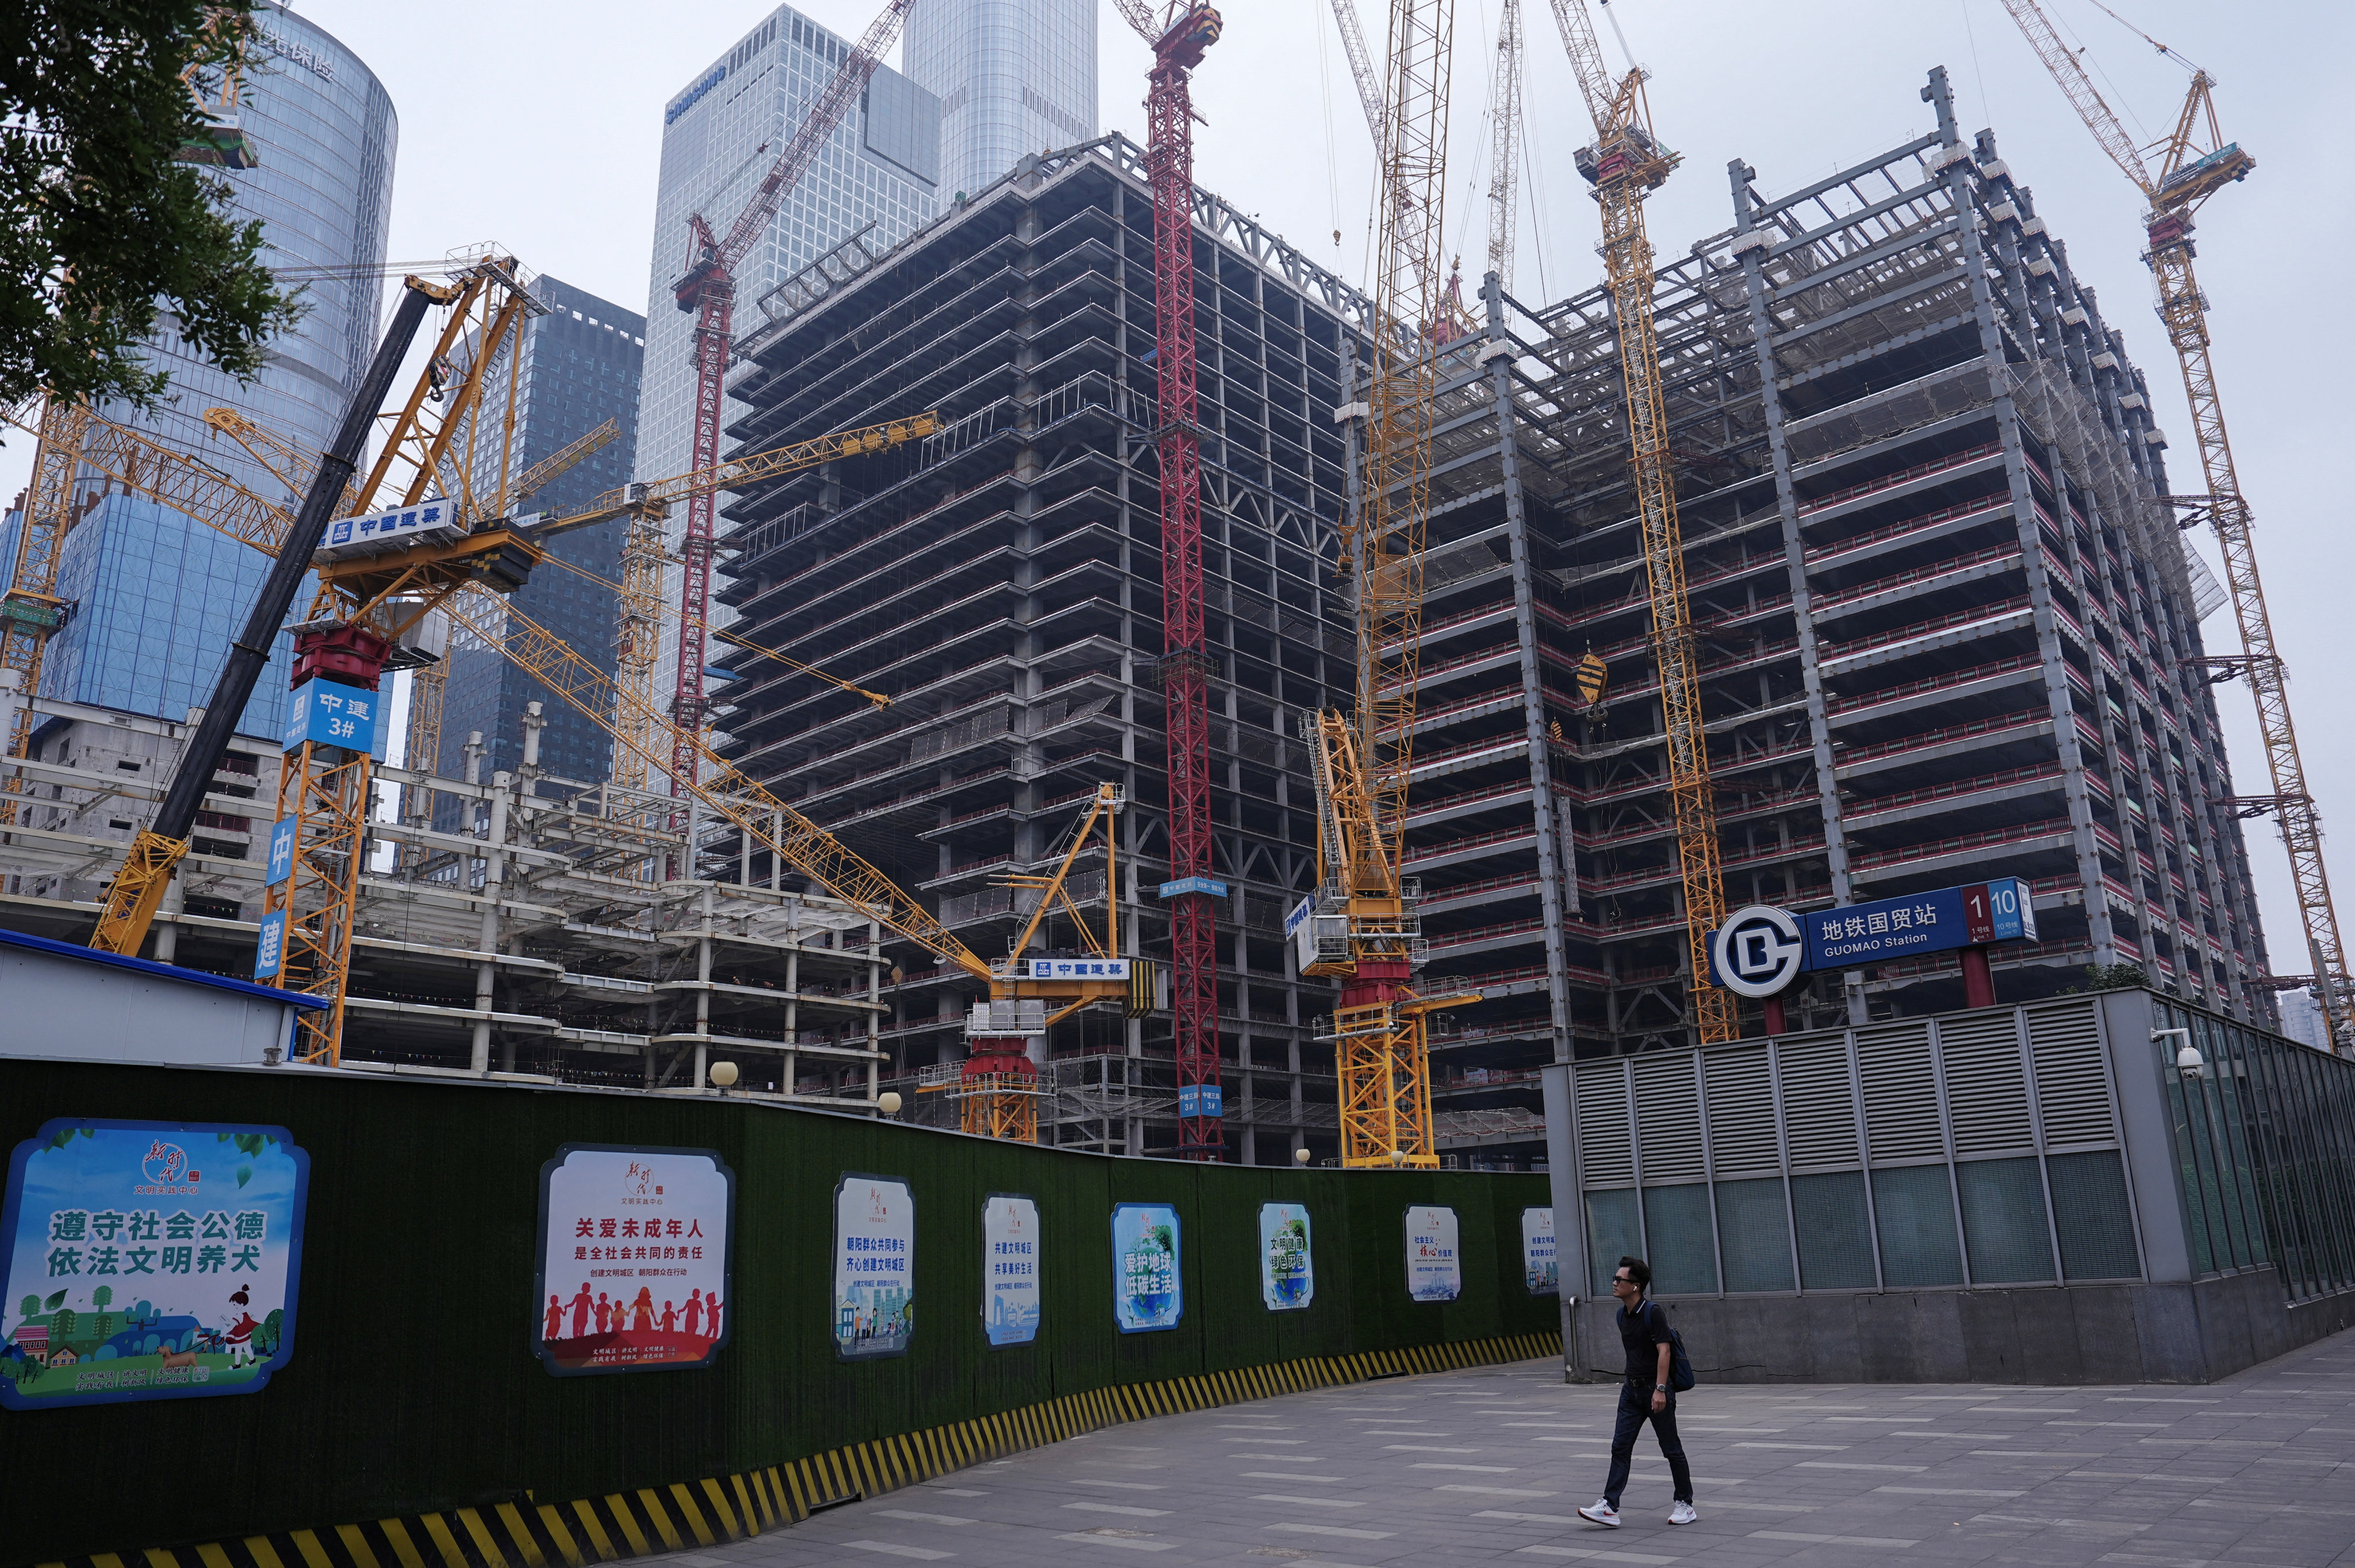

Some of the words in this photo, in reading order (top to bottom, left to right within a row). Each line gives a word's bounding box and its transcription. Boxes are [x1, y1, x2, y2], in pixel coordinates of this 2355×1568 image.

[255, 22, 335, 82] 光保险
[665, 65, 726, 125] SAMSUNG
[320, 694, 369, 721] 中建
[328, 718, 355, 738] 3#
[1970, 895, 1982, 918] 1
[1991, 890, 2016, 914] 10
[1822, 903, 1937, 941] 地铁国贸站
[1824, 940, 1880, 957] GUOMAO
[1885, 932, 1927, 948] Station
[1185, 1103, 1193, 1111] 3#
[133, 1186, 198, 1194] 文明实践中心
[52, 1211, 264, 1242] 遵守社会公德
[576, 1218, 703, 1238] 关爱未成年人
[574, 1246, 703, 1260] 是全社会共同的责任
[847, 1236, 905, 1252] 朝阳群众共同参与
[995, 1242, 1032, 1254] 共建文明城区
[1271, 1237, 1303, 1251] 文明健康
[1420, 1244, 1437, 1257] 核心
[48, 1245, 260, 1277] 依法文明养犬
[846, 1257, 905, 1272] 齐心创建文明城区
[995, 1262, 1032, 1275] 共享美好生活
[1125, 1252, 1171, 1274] 爱护地球
[1271, 1254, 1304, 1269] 绿色环保
[590, 1269, 634, 1277] 创建文明城区
[639, 1268, 687, 1277] 朝阳群众在行动
[1125, 1274, 1172, 1297] 低碳生活
[78, 1371, 114, 1380] 文明城区
[157, 1366, 189, 1375] 文明健康
[75, 1381, 113, 1390] 实践有我
